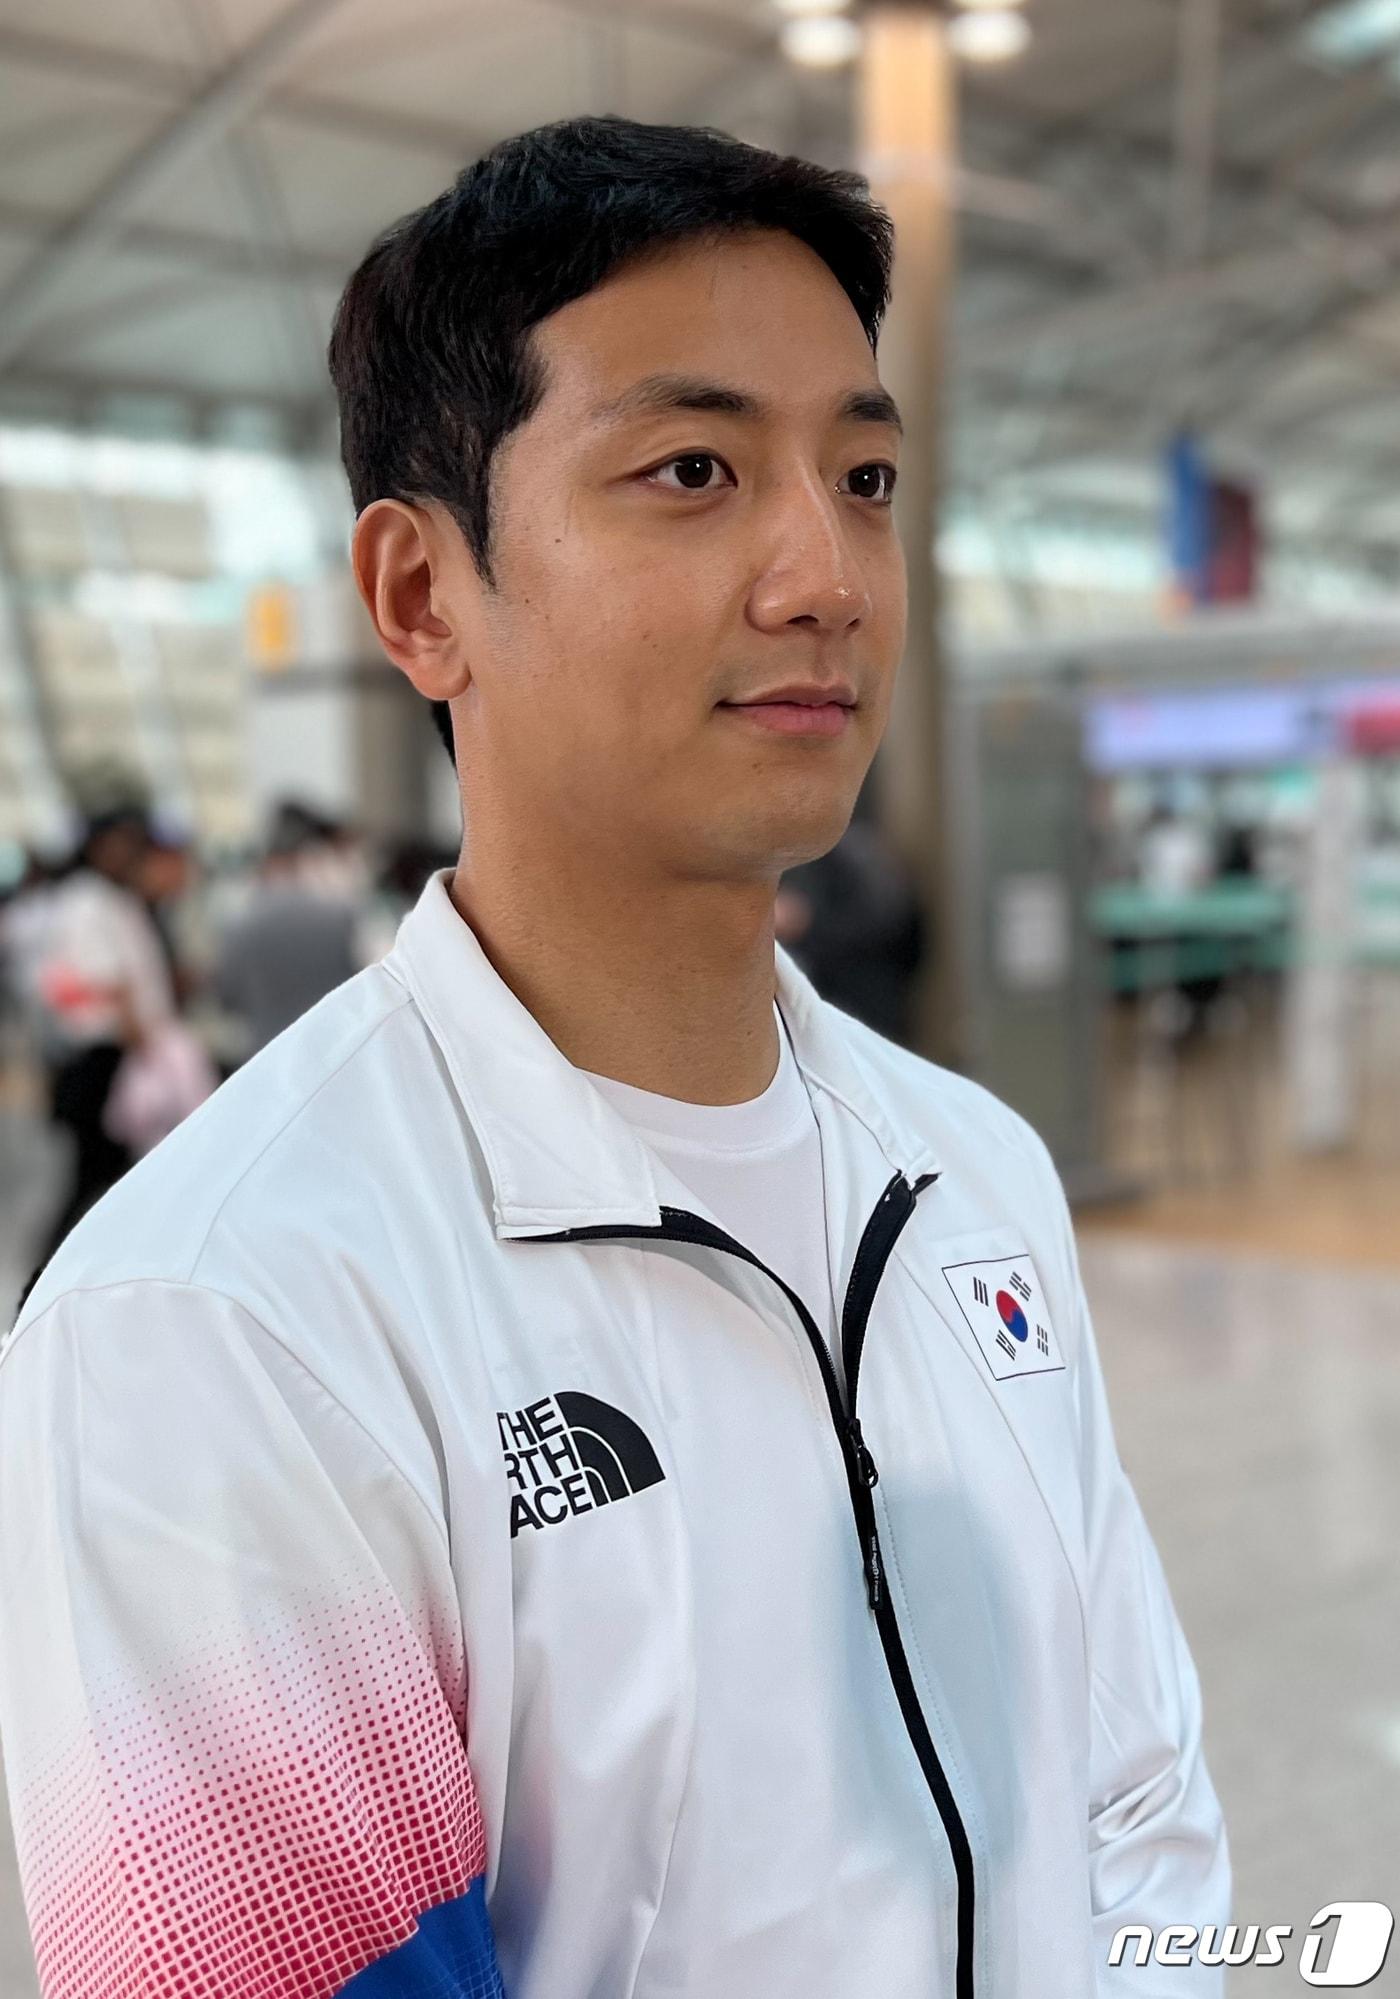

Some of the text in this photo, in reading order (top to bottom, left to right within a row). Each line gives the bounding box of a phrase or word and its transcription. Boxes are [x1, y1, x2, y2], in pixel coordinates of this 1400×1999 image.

[496, 1396, 565, 1451] THE
[504, 1432, 580, 1490] RTH
[510, 1472, 594, 1539] ACE
